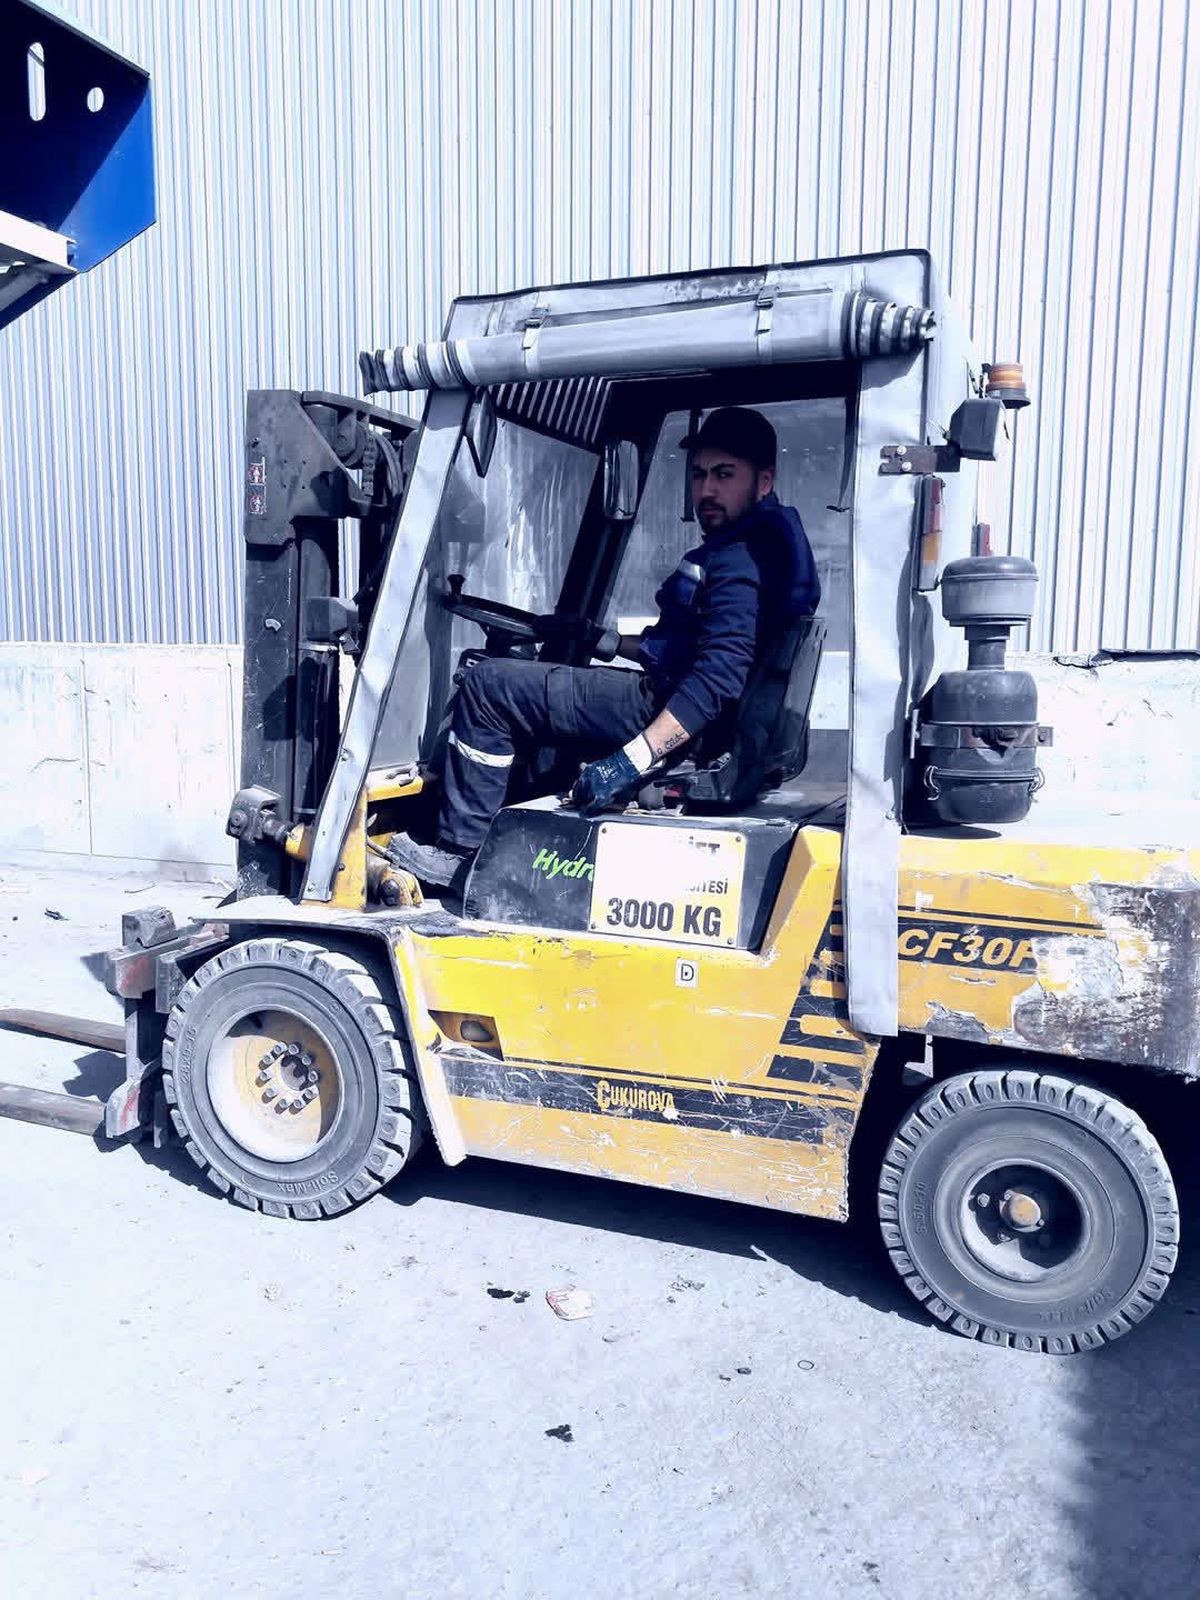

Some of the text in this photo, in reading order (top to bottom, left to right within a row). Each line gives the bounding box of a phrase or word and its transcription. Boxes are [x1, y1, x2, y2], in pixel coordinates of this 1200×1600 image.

[605, 896, 722, 937] 3000 KG
[680, 962, 695, 982] D
